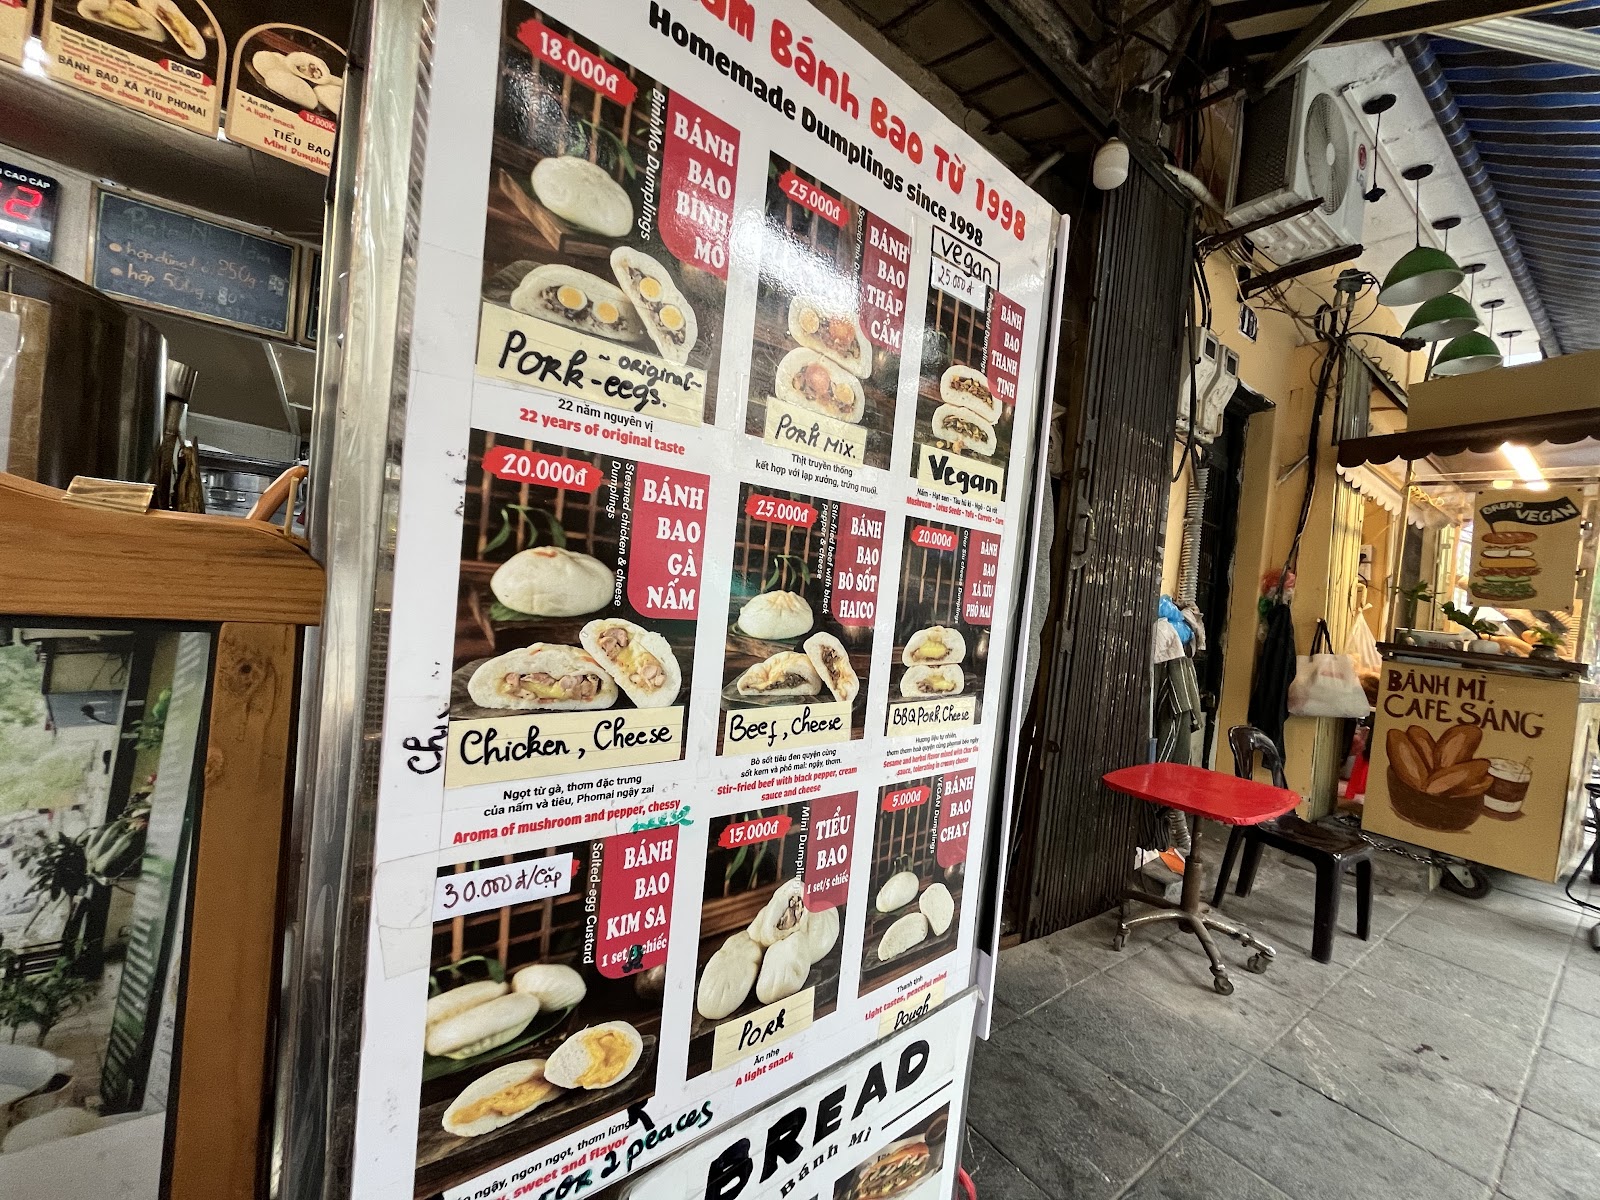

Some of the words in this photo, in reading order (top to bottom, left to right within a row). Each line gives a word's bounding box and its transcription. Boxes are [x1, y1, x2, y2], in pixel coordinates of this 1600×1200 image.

[170, 61, 202, 80] 20.000
[540, 31, 620, 94] 18.000đ
[58, 54, 91, 74] BÁNH
[96, 68, 119, 85] BAO
[167, 95, 207, 118] PHOMAI
[649, 2, 796, 121] Homemade
[801, 106, 904, 193] Dumplings
[906, 182, 947, 223] since
[949, 211, 984, 247] 1998
[770, 18, 859, 121] Bánh
[870, 96, 924, 165] Bao
[975, 178, 1026, 241] 1998
[307, 142, 331, 158] BAO
[673, 111, 736, 168] BÁNH
[686, 157, 732, 200] BAO
[636, 154, 661, 241] Dumplings
[788, 178, 842, 222] 25.000đ
[674, 189, 730, 237] BÌNH
[869, 224, 909, 265] BÁNH
[877, 258, 906, 289] BAO
[1000, 304, 1023, 332] BÁNH
[1003, 331, 1020, 354] BAO
[991, 350, 1018, 377] THANH
[996, 376, 1016, 399] TỊNH
[558, 398, 573, 413] 22
[576, 402, 601, 419] năm
[603, 409, 643, 428] nguyên
[644, 420, 654, 432] vị
[519, 407, 538, 424] 22
[541, 413, 581, 434] years
[584, 422, 600, 437] of
[601, 425, 652, 449] original
[654, 437, 686, 456] taste
[500, 453, 588, 487] 20.000đ
[755, 459, 769, 471] kết
[770, 462, 787, 476] hợp
[788, 466, 800, 478] với
[801, 470, 813, 482] lạp
[606, 460, 622, 520] Dumplings
[642, 475, 705, 511] BÁNH
[755, 499, 810, 524] 25.000đ
[1482, 501, 1524, 515] BREAD
[1515, 504, 1577, 523] VEGAN
[620, 512, 632, 556] chicken
[656, 516, 701, 544] BAO
[850, 513, 883, 540] BÁNH
[917, 529, 953, 548] 20.000đ
[617, 556, 628, 568] &
[856, 546, 880, 566] BAO
[980, 538, 999, 557] BÁNH
[667, 549, 698, 578] GÀ
[982, 562, 996, 577] BAO
[613, 568, 626, 607] cheese
[646, 577, 696, 611] NẤM
[837, 567, 854, 591] BÒ
[855, 566, 877, 593] SỐT
[839, 599, 874, 619] HAICO
[979, 602, 992, 618] MAI
[1387, 669, 1450, 697] BÁNH
[893, 707, 916, 726] BBQ
[1383, 694, 1452, 723] CAFE
[1456, 699, 1545, 739] SÁNG
[593, 716, 673, 751] Cheese
[750, 757, 761, 766] Bò
[774, 753, 787, 763] tiêu
[788, 752, 801, 761] đen
[753, 766, 769, 777] kem
[770, 765, 778, 774] và
[503, 787, 531, 802] Ngọt
[534, 785, 547, 799] từ
[548, 783, 565, 798] gà,
[567, 779, 594, 793] thơm
[596, 775, 615, 790] đặc
[717, 780, 757, 796] Stir-fried
[757, 777, 775, 789] beef
[776, 774, 793, 786] with
[793, 772, 813, 784] black
[813, 769, 838, 782] pepper,
[838, 766, 858, 777] cream
[761, 790, 783, 802] sauce
[783, 786, 797, 797] and
[798, 783, 822, 795] cheese
[944, 775, 975, 796] BÁNH
[483, 803, 506, 818] của
[508, 799, 534, 814] nấm
[536, 798, 549, 811] và
[551, 794, 575, 809] tiêu,
[577, 788, 615, 805] Phomai
[616, 786, 641, 801] ngậy
[641, 784, 655, 795] zai
[891, 789, 922, 808] 5.000đ
[949, 798, 972, 818] BAO
[453, 827, 498, 846] Aroma
[501, 821, 516, 838] of
[517, 813, 583, 835] mushroom
[584, 808, 606, 824] and
[607, 804, 646, 824] pepper,
[648, 799, 681, 815] chessy
[729, 819, 780, 844] 15.000đ
[800, 806, 811, 831] Mini
[815, 805, 852, 841] TIỂU
[939, 820, 970, 843] CHAY
[623, 839, 674, 870] BÁNH
[815, 844, 848, 871] BAO
[634, 871, 670, 901] BAO
[831, 869, 850, 887] chiếc
[605, 916, 640, 941] KIM
[644, 907, 667, 930] SA
[583, 915, 598, 965] Custard
[735, 1076, 744, 1088] A
[744, 1065, 767, 1083] light
[768, 1051, 795, 1072] snack
[704, 1039, 930, 1200] BREAD
[511, 1161, 542, 1184] ngon
[577, 1130, 606, 1151] thơm
[513, 1168, 559, 1199] sweet
[561, 1153, 587, 1176] and
[589, 1135, 629, 1161] flavor
[780, 1143, 839, 1199] Bánh
